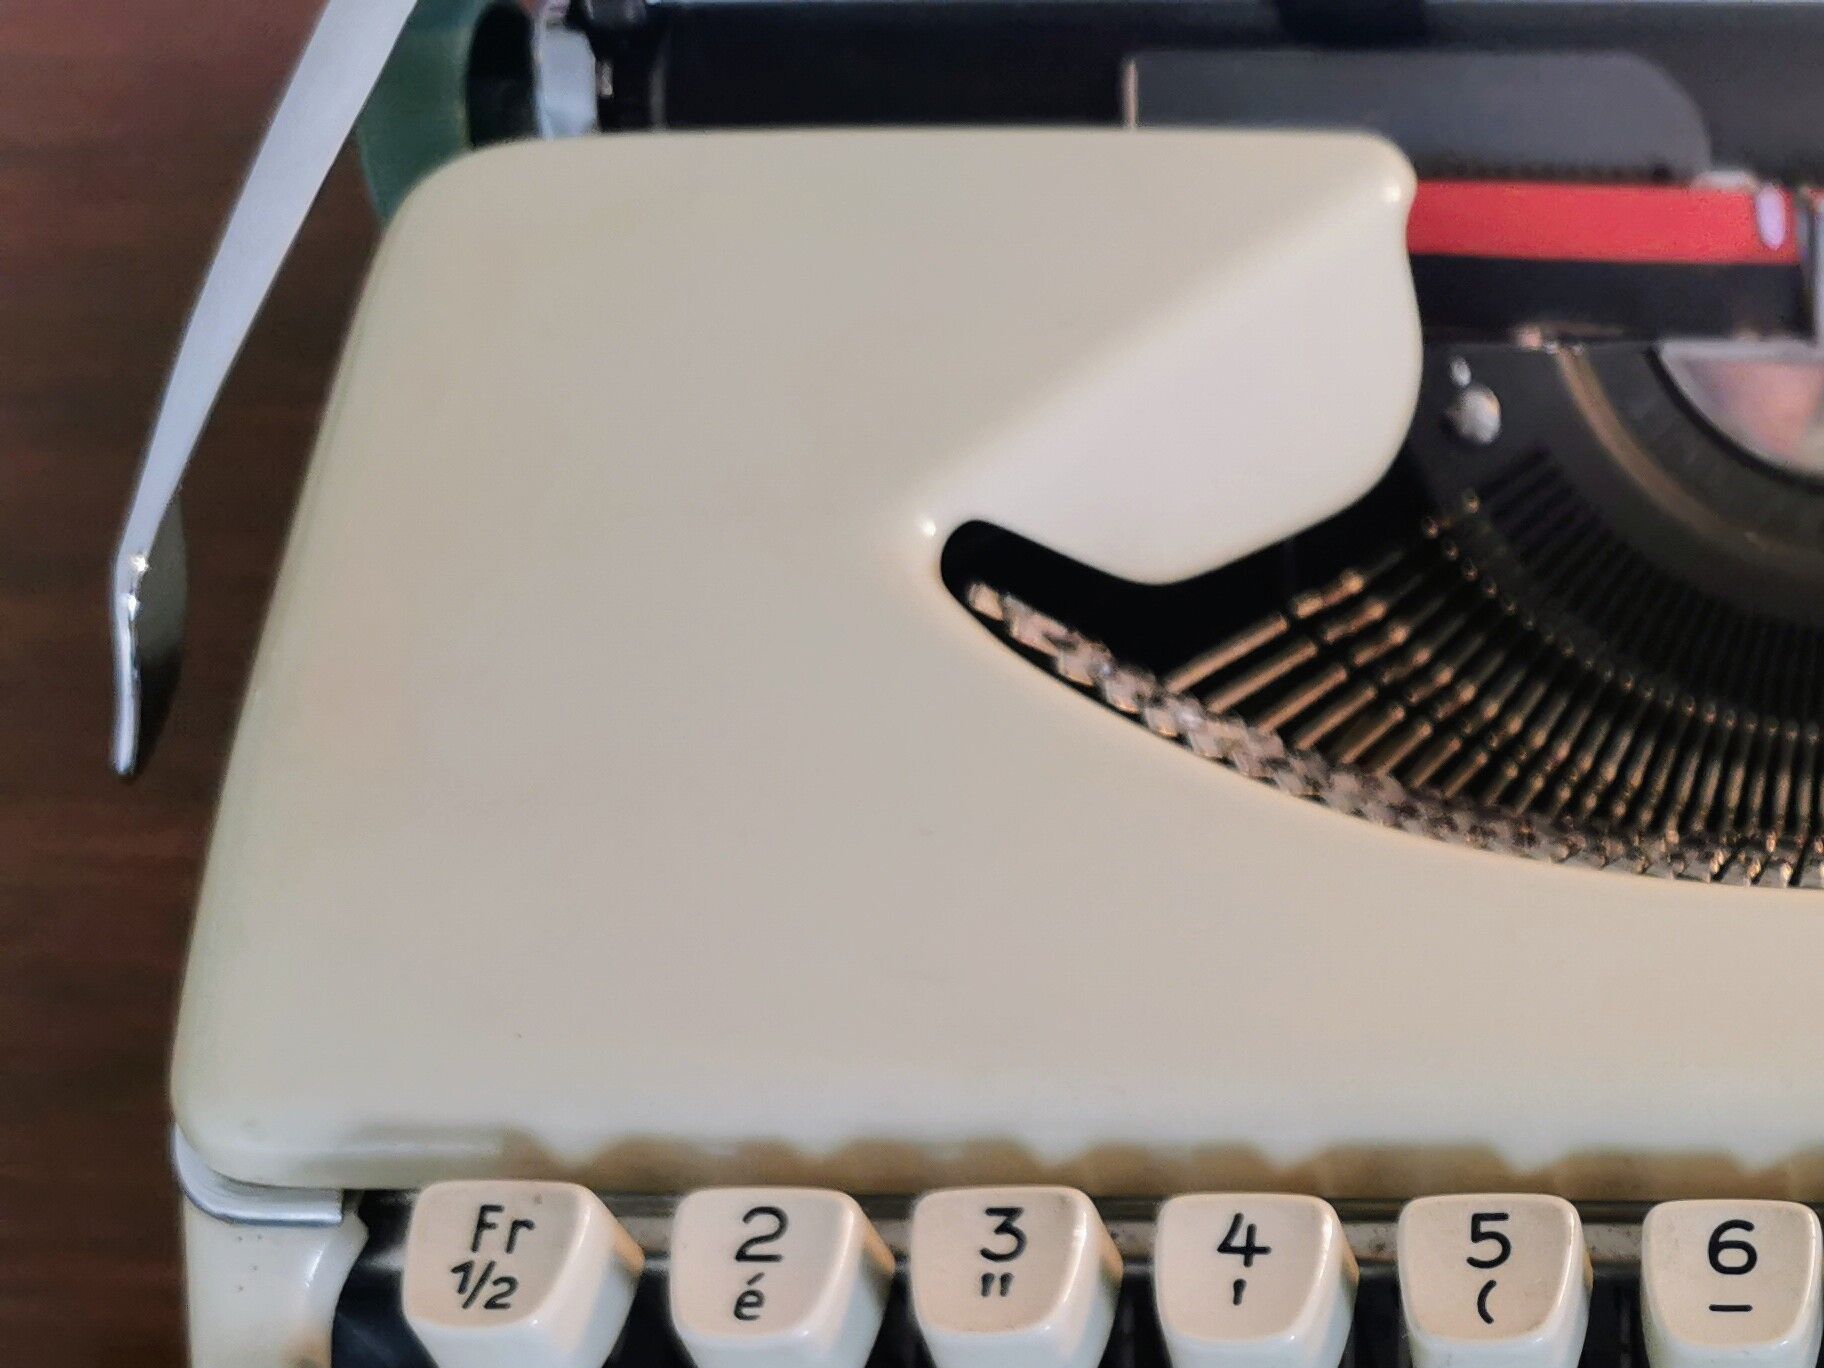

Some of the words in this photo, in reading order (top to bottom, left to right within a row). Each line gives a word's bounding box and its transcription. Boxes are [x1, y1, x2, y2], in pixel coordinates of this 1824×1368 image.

[471, 1205, 534, 1253] Fr
[734, 1206, 787, 1262] 2
[980, 1207, 1026, 1262] 3
[1217, 1213, 1270, 1267] 4
[1467, 1213, 1511, 1269] 5
[1708, 1220, 1757, 1275] 6
[733, 1273, 764, 1321] é
[1477, 1280, 1496, 1324] (
